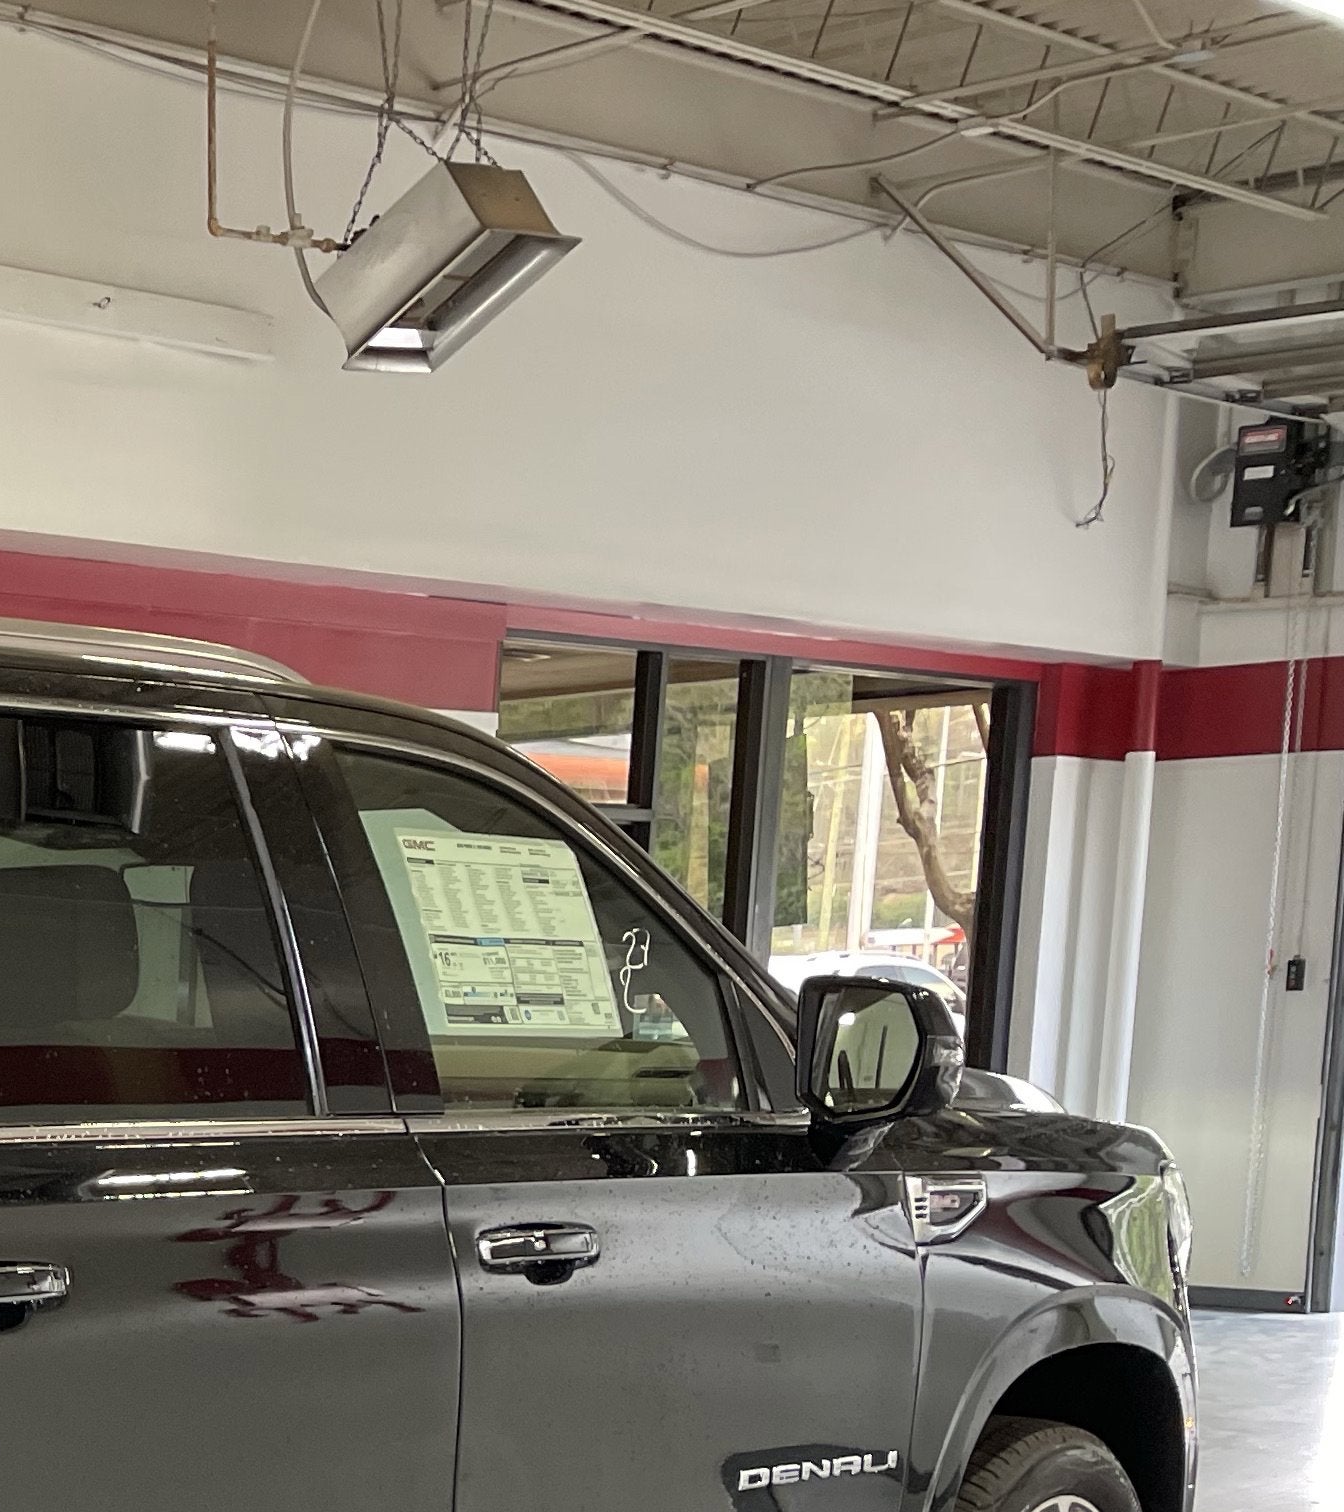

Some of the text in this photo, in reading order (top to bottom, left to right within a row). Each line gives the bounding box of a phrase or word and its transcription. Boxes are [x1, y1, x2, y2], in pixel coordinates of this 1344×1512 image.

[402, 839, 435, 850] GMC
[438, 951, 451, 967] 16
[738, 1450, 899, 1491] DENALI
